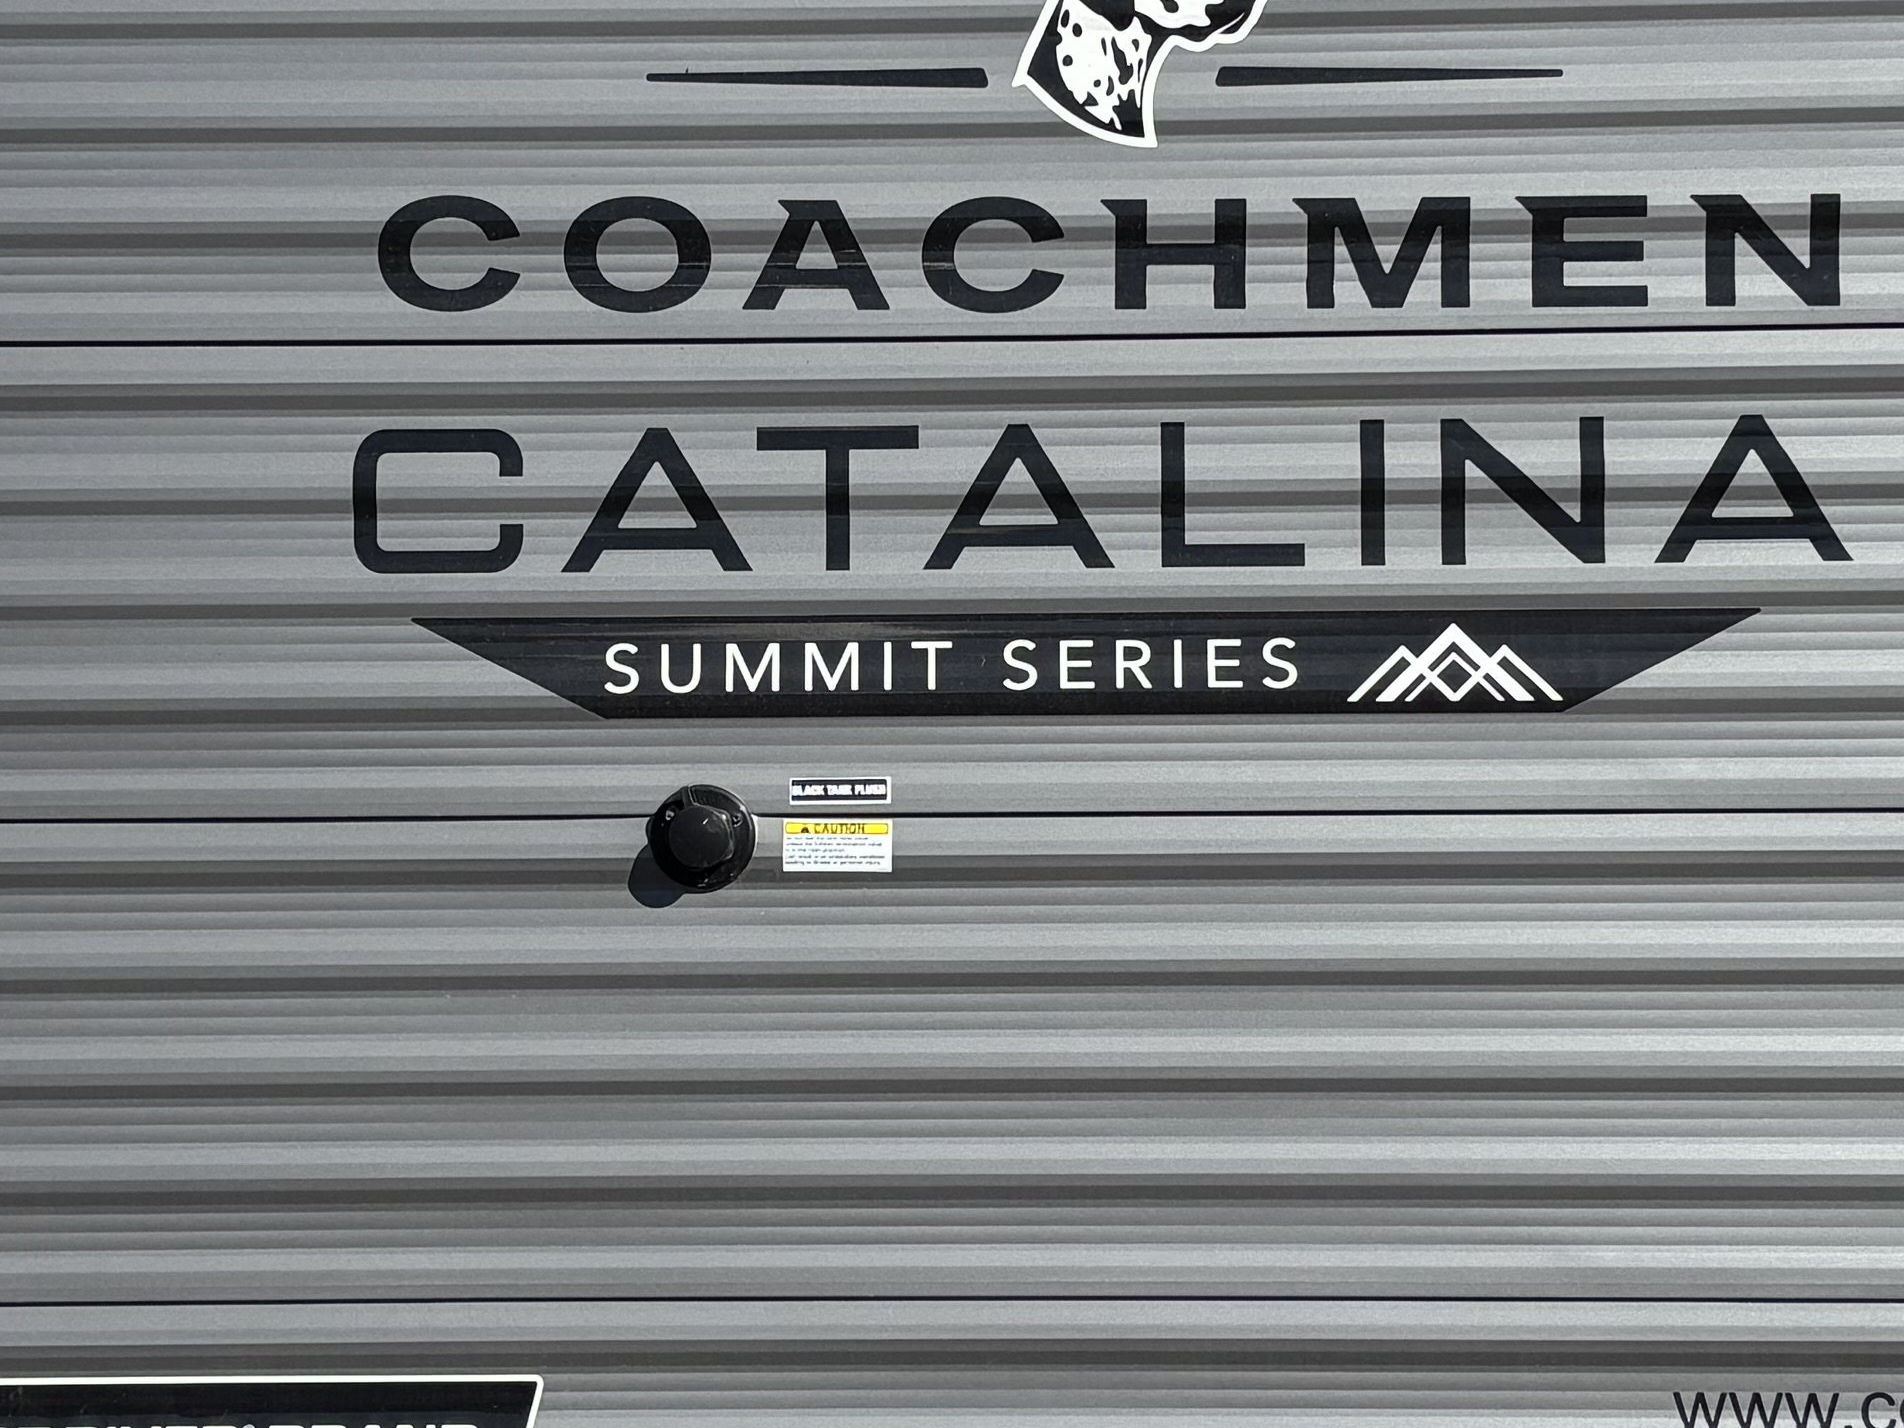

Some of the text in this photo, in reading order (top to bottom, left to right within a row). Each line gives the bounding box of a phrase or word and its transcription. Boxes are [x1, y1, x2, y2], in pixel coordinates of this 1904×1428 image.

[377, 193, 1842, 313] COACHMEN
[352, 414, 1853, 573] CATALINA
[603, 637, 1299, 694] SUMMIT SERIES
[814, 822, 865, 834] CAUTION
